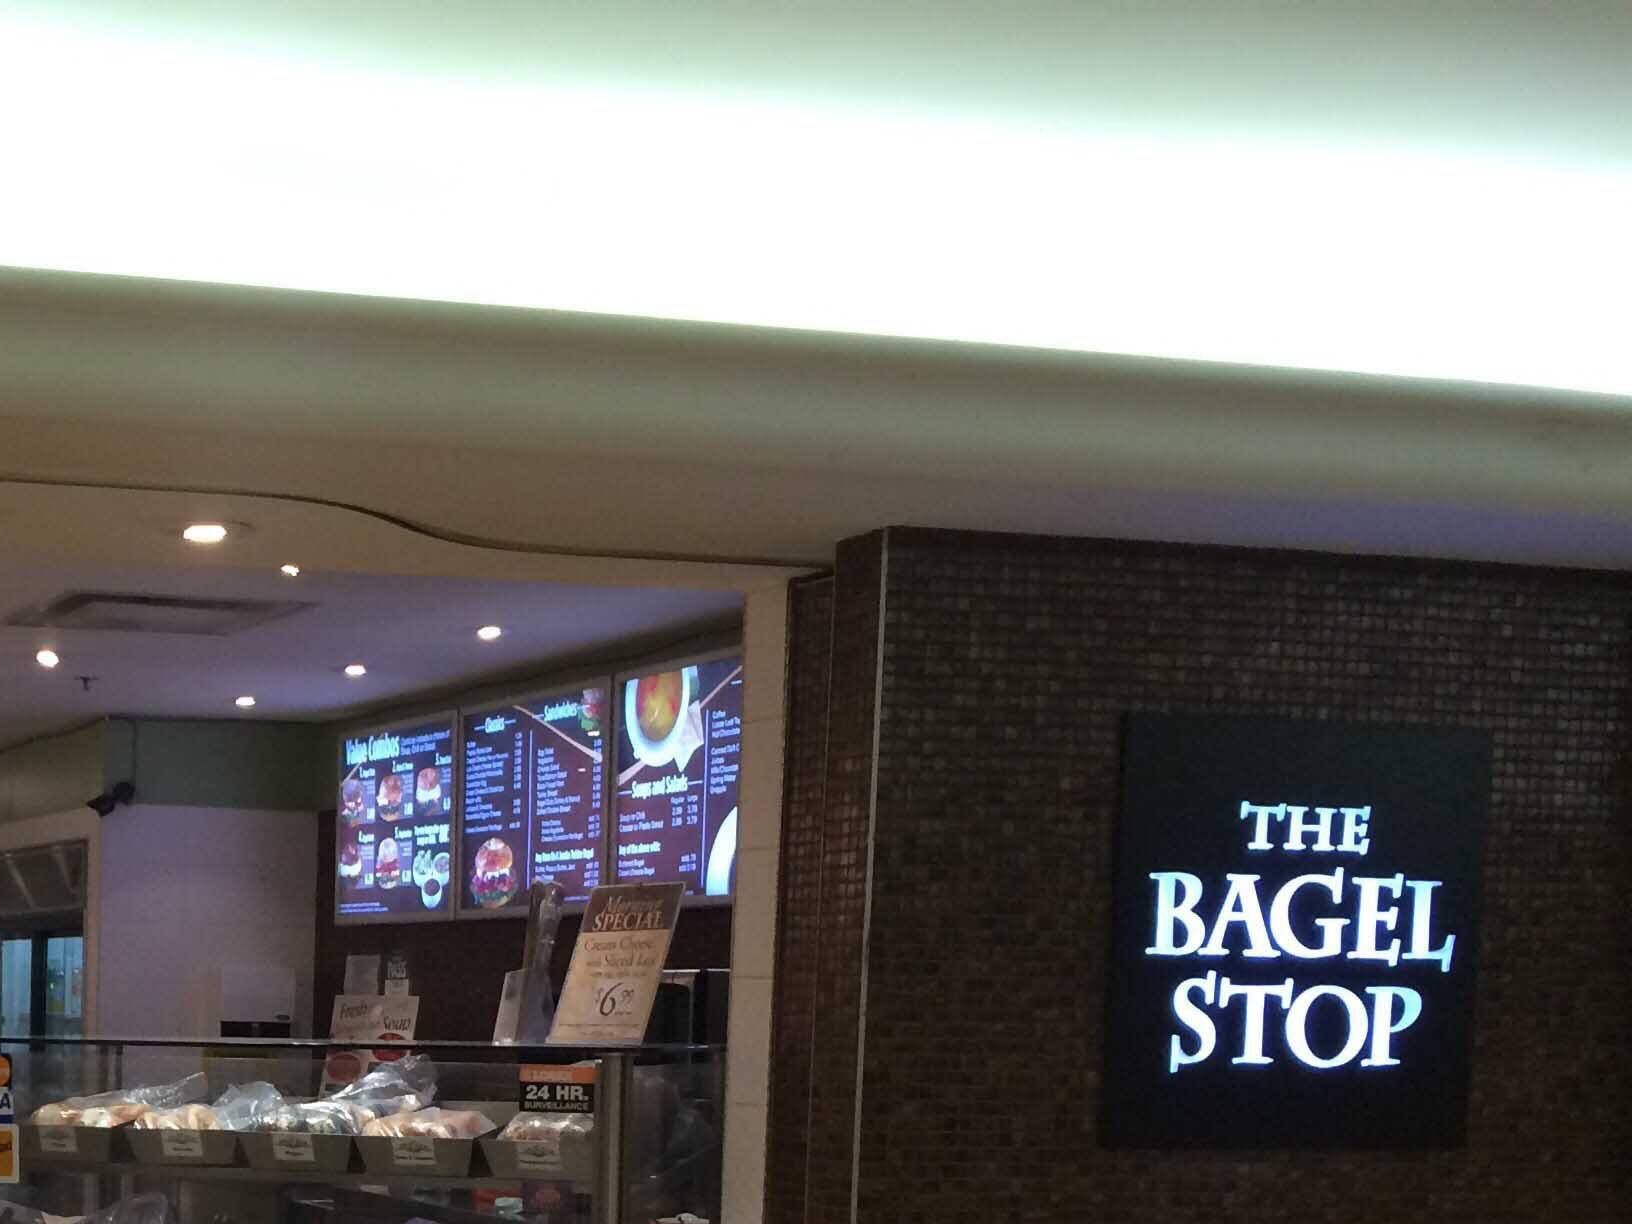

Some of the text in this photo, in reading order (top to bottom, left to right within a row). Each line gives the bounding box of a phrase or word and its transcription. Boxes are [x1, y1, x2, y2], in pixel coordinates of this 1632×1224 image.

[368, 733, 400, 761] Combos
[1240, 800, 1372, 855] THE
[592, 911, 665, 932] SPECIAL
[1145, 867, 1456, 972] BAGEL
[1169, 970, 1423, 1073] STOP
[526, 1084, 589, 1101] 24 HR.
